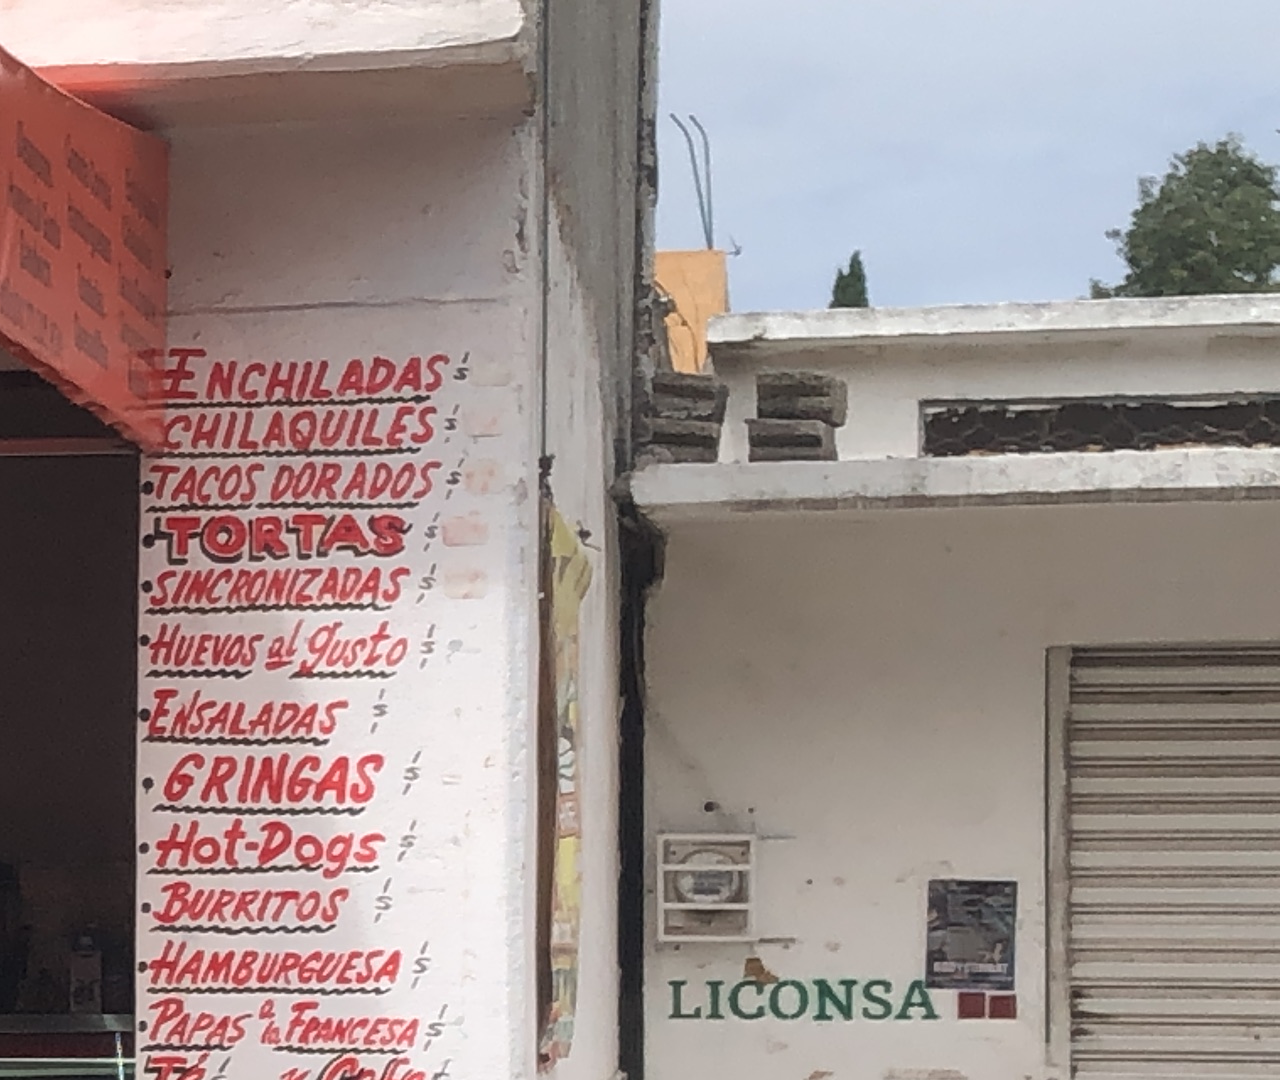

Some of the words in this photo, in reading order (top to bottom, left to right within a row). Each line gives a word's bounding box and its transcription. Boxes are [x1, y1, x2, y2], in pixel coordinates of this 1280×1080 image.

[161, 348, 449, 401] ENCHILADAS
[160, 405, 437, 450] CHILAQUILES
[150, 463, 265, 503] TACOS
[270, 461, 442, 502] DORADOS
[154, 513, 413, 565] TORTAS
[150, 566, 410, 607] SINCRONIZADAS
[148, 688, 349, 737] ENSALADAS
[163, 752, 385, 804] GRINGAS
[155, 818, 386, 879] Hot-Dogs
[152, 881, 349, 924] BURRITOS
[148, 939, 402, 985] HAMBURGUESA
[149, 998, 253, 1043] PAPAS
[284, 1001, 420, 1047] FRANCESA
[667, 978, 941, 1021] LICONSA
